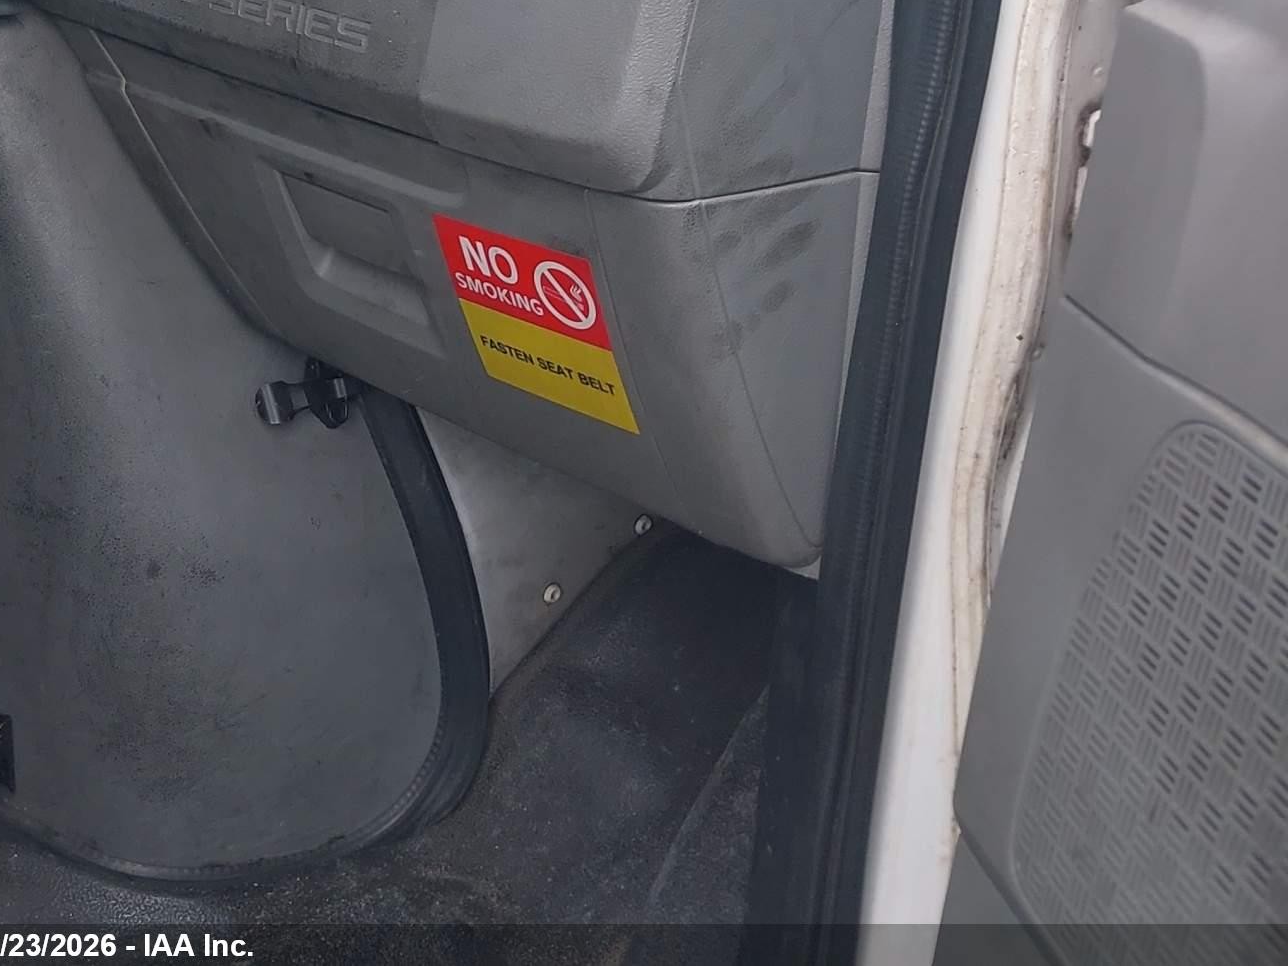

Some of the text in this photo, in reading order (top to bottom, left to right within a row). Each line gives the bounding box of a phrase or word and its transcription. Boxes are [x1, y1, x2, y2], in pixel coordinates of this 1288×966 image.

[458, 234, 519, 284] NO
[455, 272, 545, 316] SMOKING
[480, 334, 616, 396] FASTEN SEAT BELT
